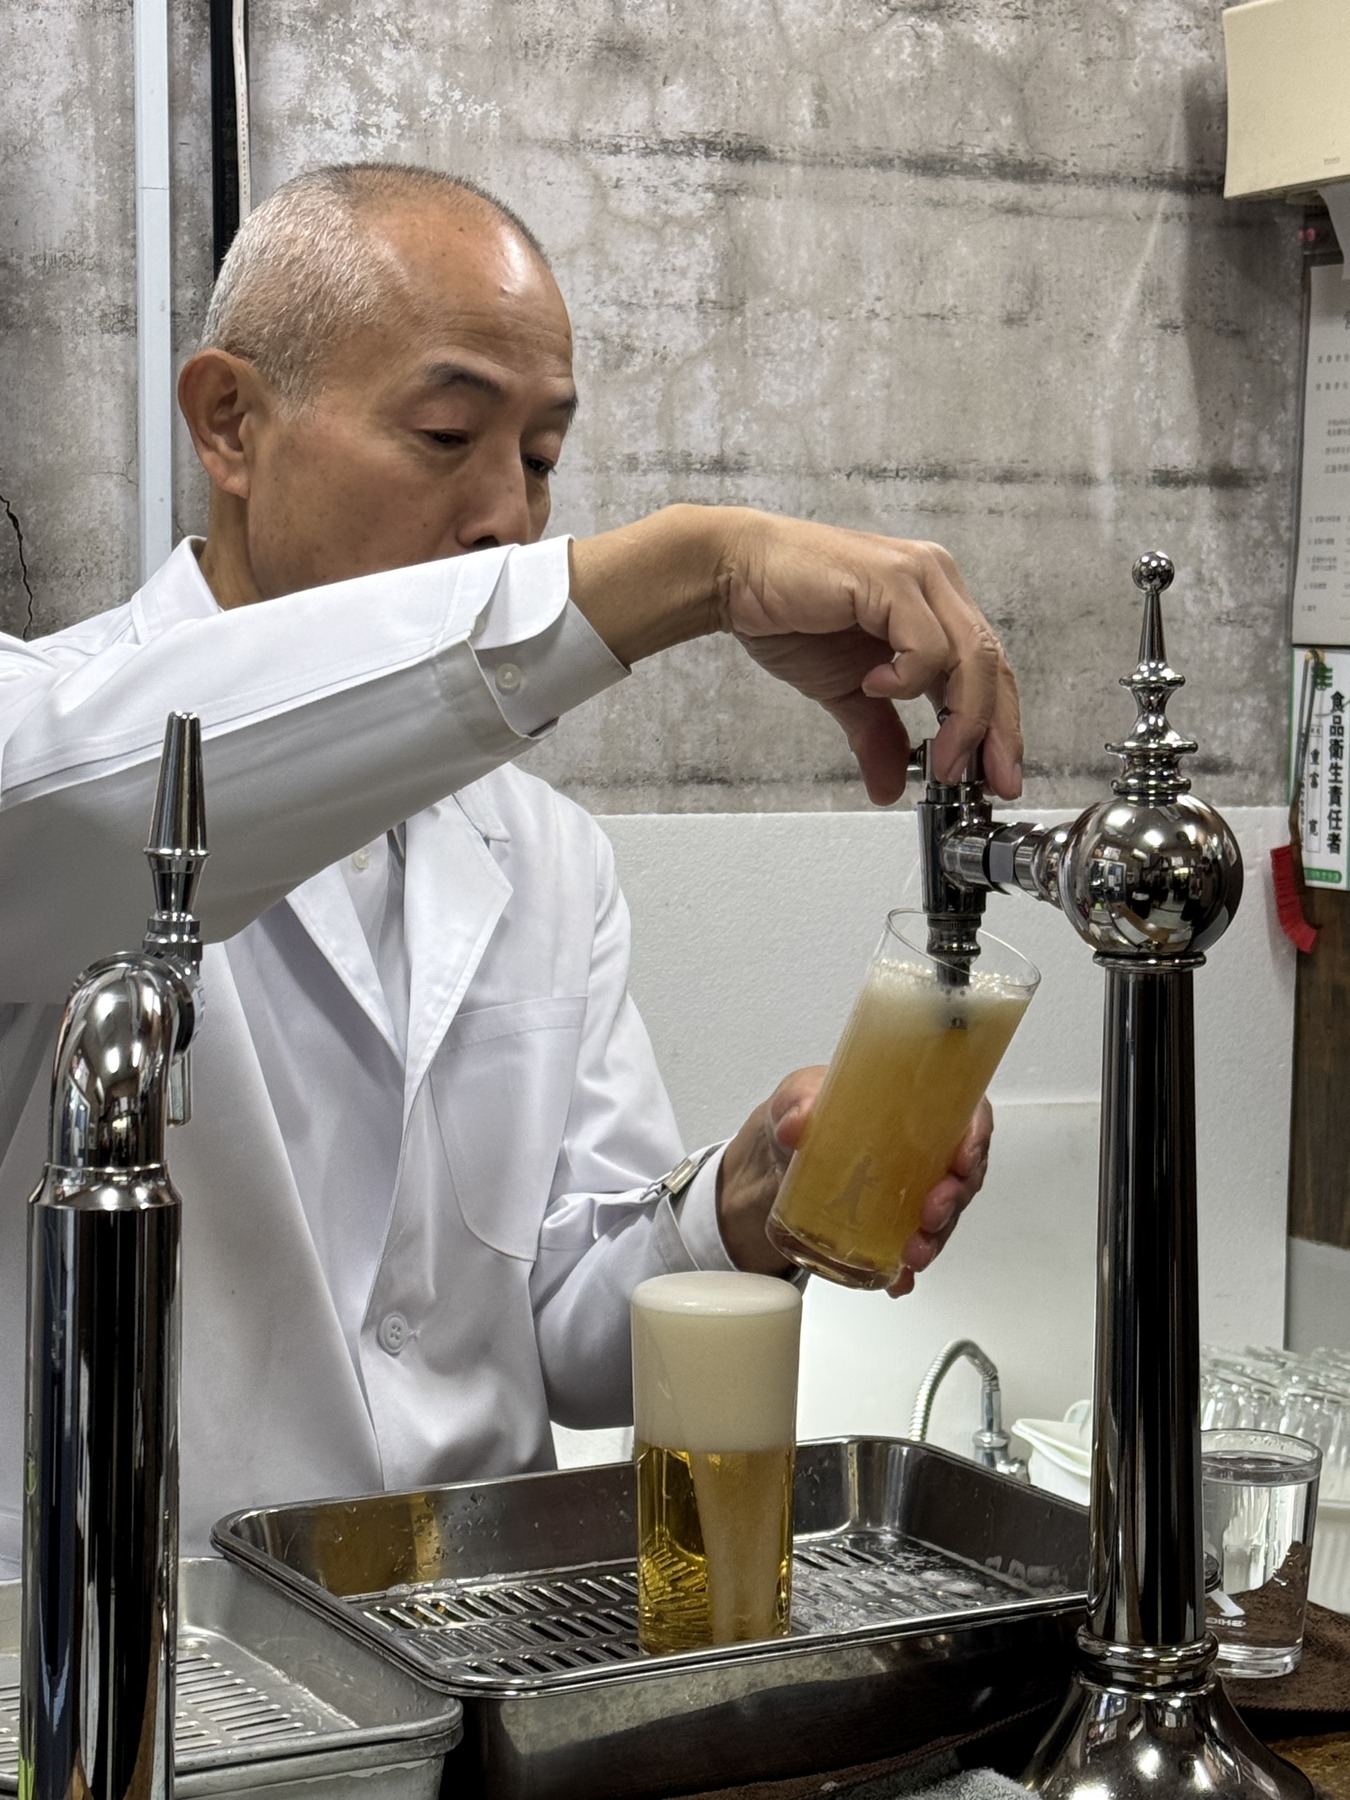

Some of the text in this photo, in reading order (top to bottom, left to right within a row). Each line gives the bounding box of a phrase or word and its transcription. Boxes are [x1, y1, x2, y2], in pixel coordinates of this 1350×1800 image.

[1327, 691, 1344, 855] 食品衛生責任者
